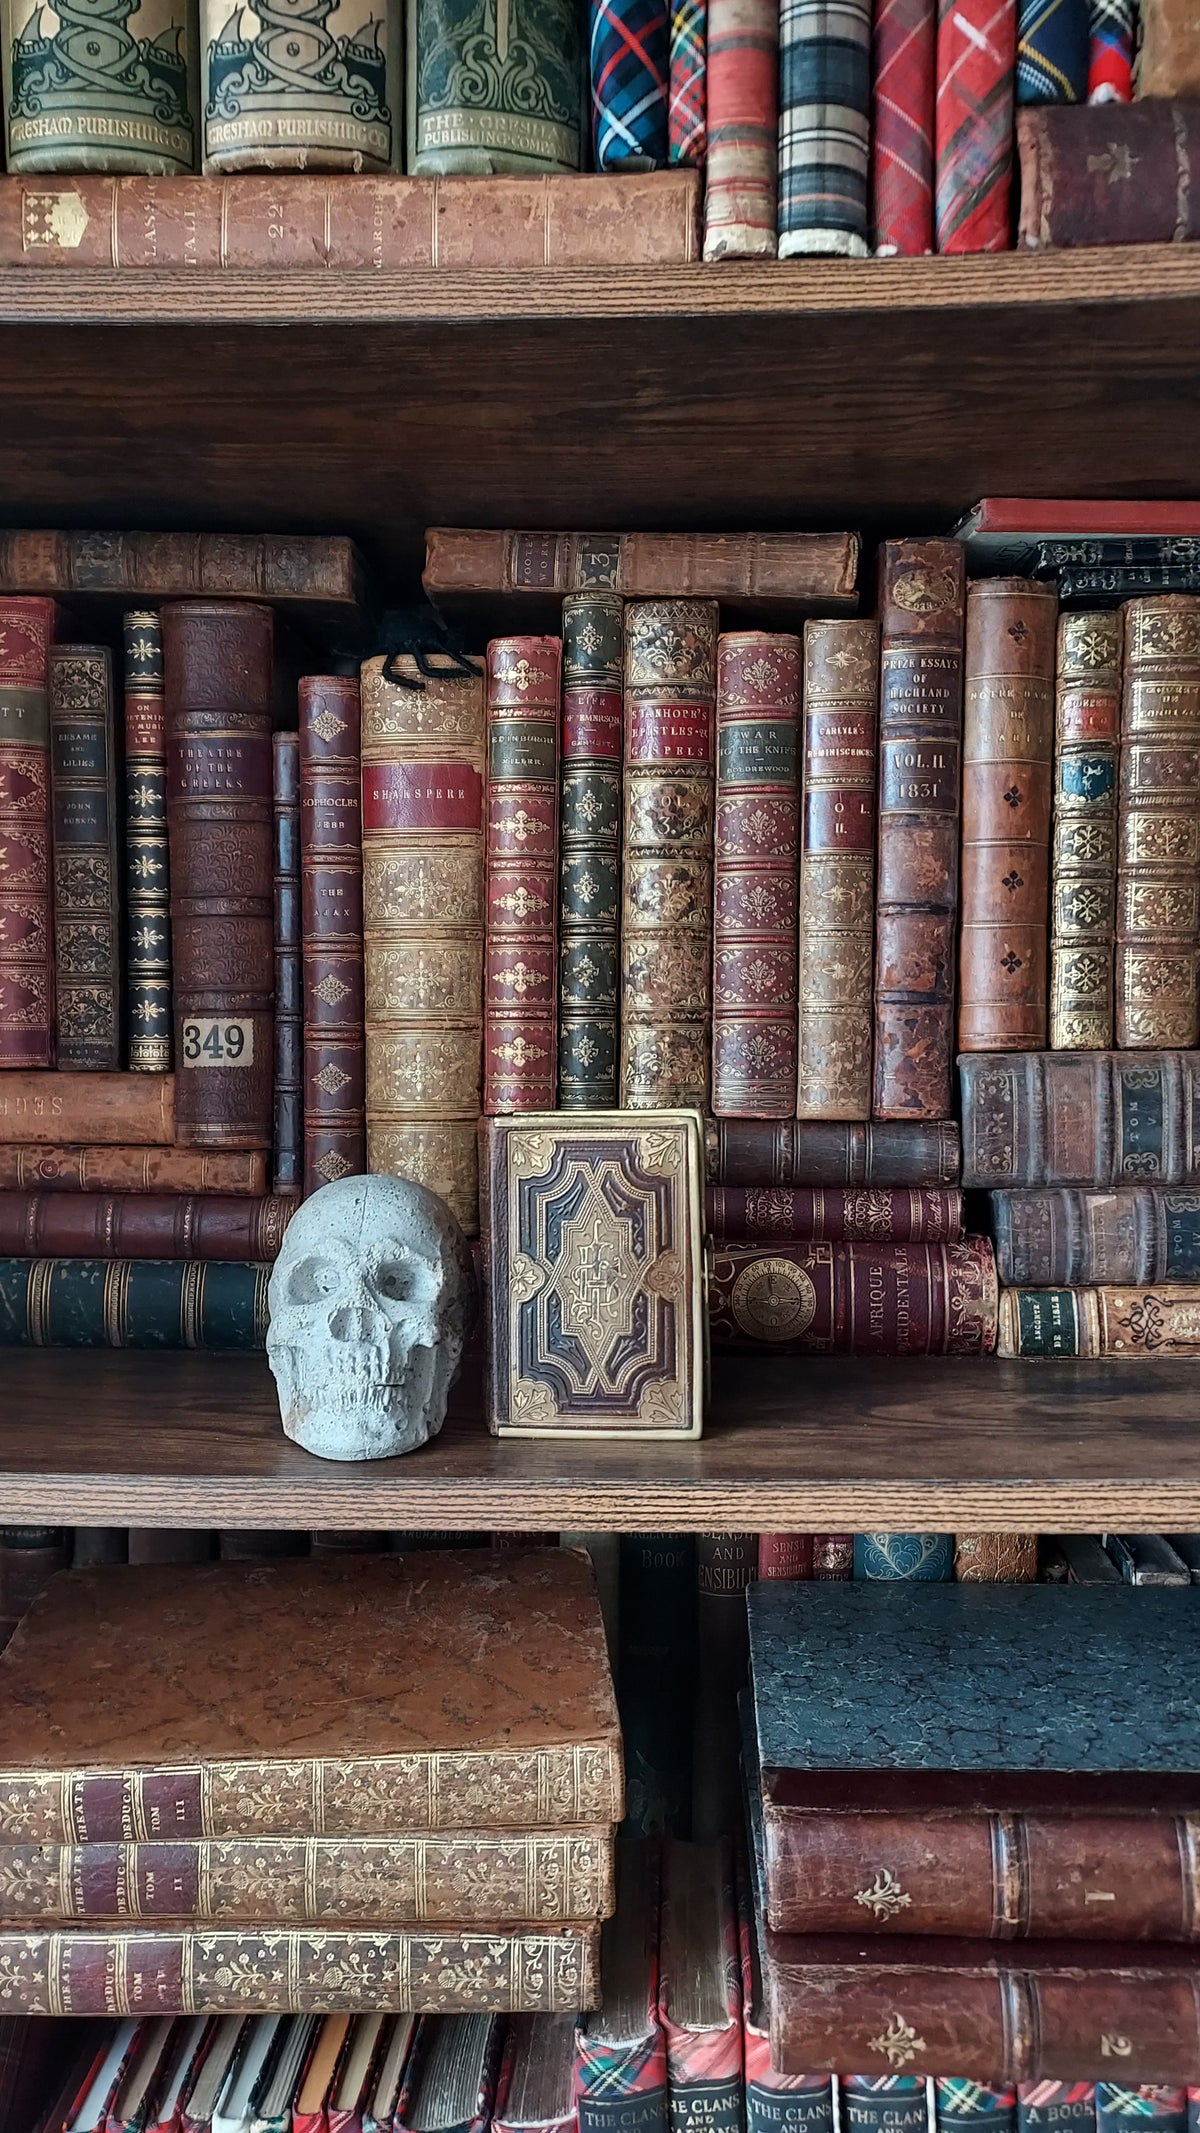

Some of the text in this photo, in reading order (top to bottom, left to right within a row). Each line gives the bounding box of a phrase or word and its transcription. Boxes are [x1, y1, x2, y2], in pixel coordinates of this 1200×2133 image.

[423, 113, 464, 131] THE
[12, 117, 73, 141] GRESHAM
[77, 117, 169, 145] PUBLISHING
[208, 121, 273, 145] GRESHAM
[277, 119, 367, 142] PUBLISHING
[884, 658, 958, 670] PRIZE ESSAYS
[913, 674, 928, 683] OF
[890, 688, 950, 699] HIGHLAND
[578, 696, 606, 706] LIFE
[632, 708, 707, 720] STANHOPE'S
[893, 704, 945, 715] SOCIETY
[740, 731, 777, 739] WAR
[819, 723, 865, 735] CARLYLE'S
[179, 748, 242, 758] THEATRE
[632, 746, 704, 757] GOSPELS
[739, 746, 759, 754] THE
[894, 753, 930, 769] VOL.
[186, 763, 233, 773] OF THE
[181, 779, 243, 788] GREEKS
[373, 788, 465, 800] SHAKSPERE
[899, 783, 938, 798] 1831
[302, 798, 358, 808] SOPHOCLES
[315, 821, 345, 829] JEBB
[185, 1024, 245, 1060] 349
[1129, 1101, 1138, 1142] TOM
[1147, 1117, 1157, 1126] V
[1172, 1219, 1183, 1257] TOM
[869, 1266, 886, 1341] AFRIQUE
[1051, 1295, 1062, 1348] DE LISLE
[713, 1547, 744, 1560] AND
[779, 1556, 798, 1564] AND
[175, 1800, 185, 1821] III
[150, 1806, 161, 1832] TOM
[145, 1871, 155, 1900] TOM
[174, 1877, 183, 1891] II
[133, 1972, 143, 2002] TOM
[1101, 2033, 1132, 2057] 2
[671, 2093, 740, 2114] HE CLANS
[752, 2099, 782, 2121] THE
[584, 2110, 616, 2128] THE
[686, 2115, 715, 2127] AND
[847, 2106, 878, 2124] THE
[1026, 2108, 1041, 2123] A
[780, 2124, 808, 2133] AND
